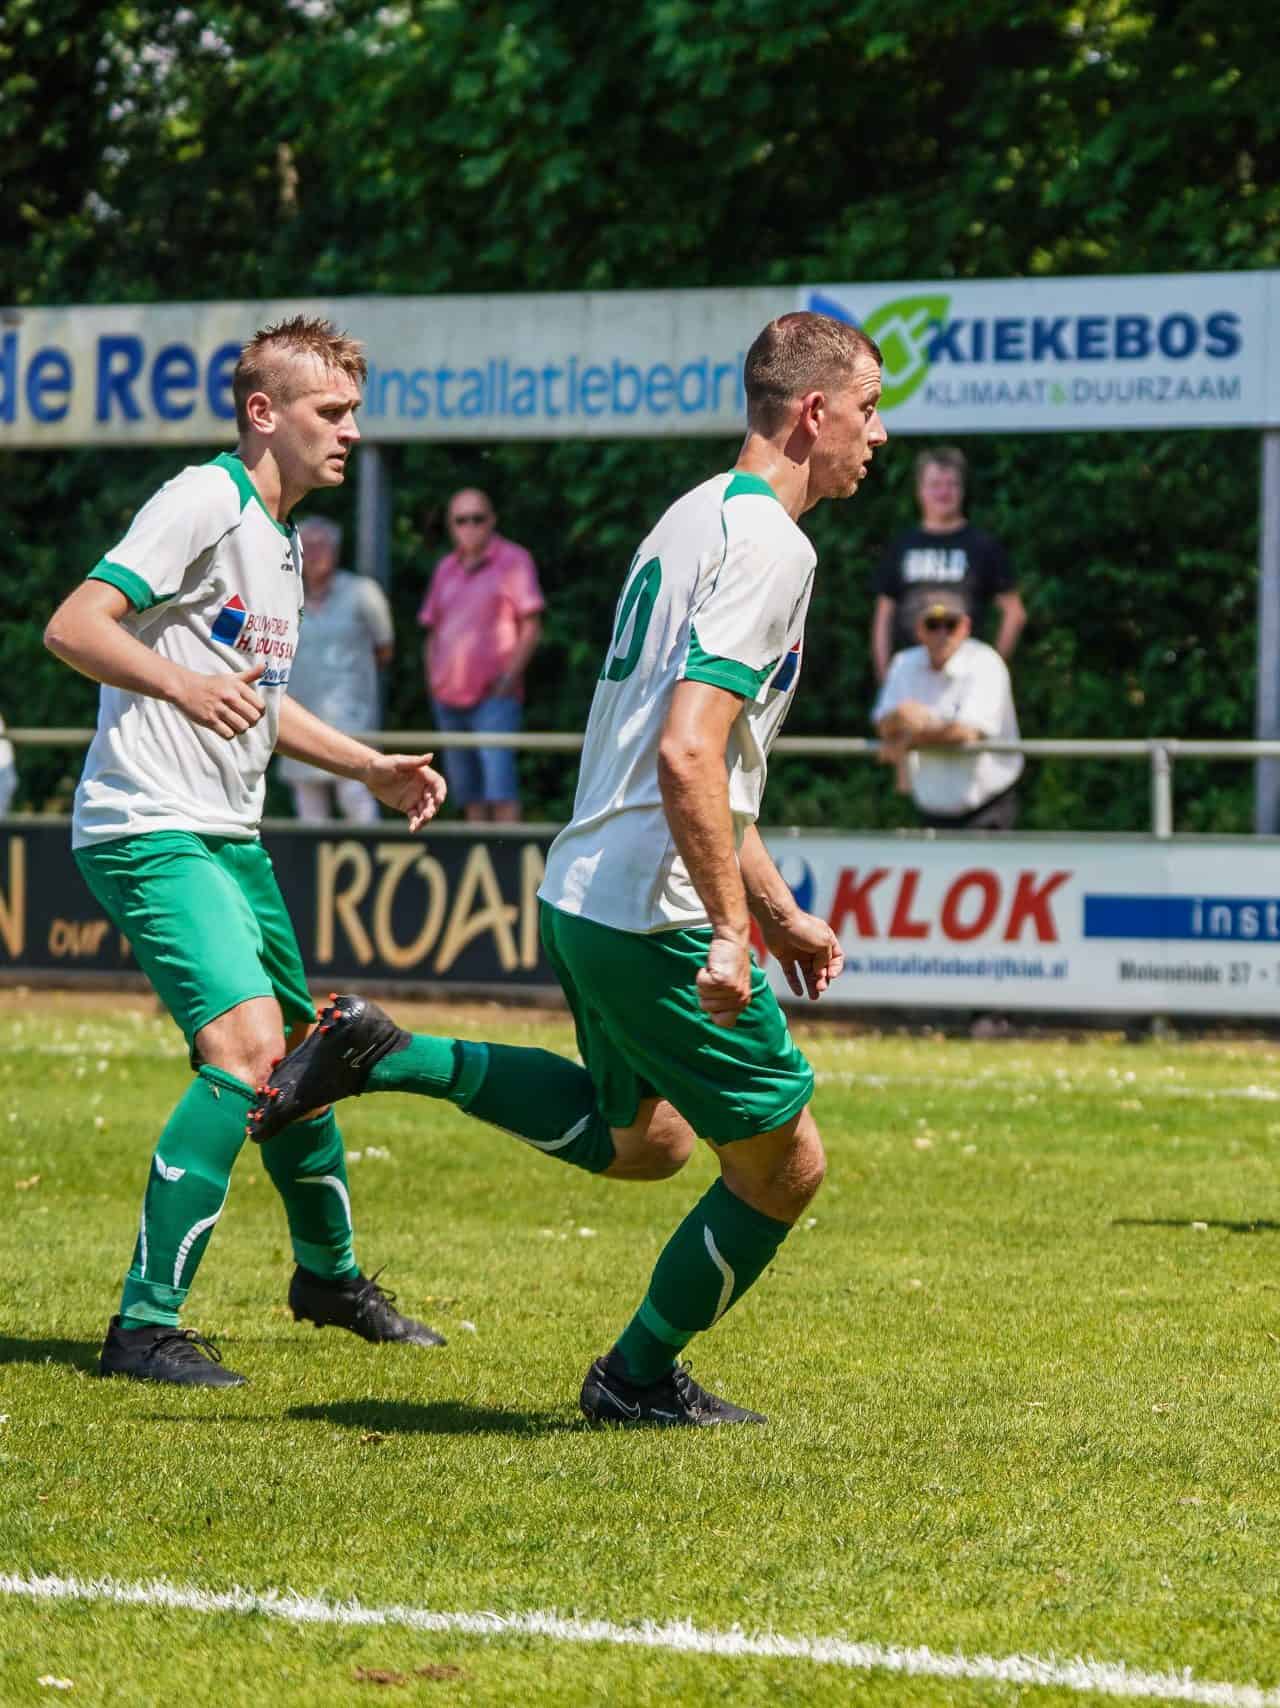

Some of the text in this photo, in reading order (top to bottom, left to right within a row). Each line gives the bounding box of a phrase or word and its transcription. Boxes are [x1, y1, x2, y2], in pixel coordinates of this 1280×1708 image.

[926, 309, 1243, 365] KIEKEBOS
[96, 335, 241, 423] Ree
[366, 351, 746, 419] Installatiebedri
[600, 553, 662, 682] 0
[315, 840, 545, 974] ROA
[828, 866, 1075, 943] KLOK
